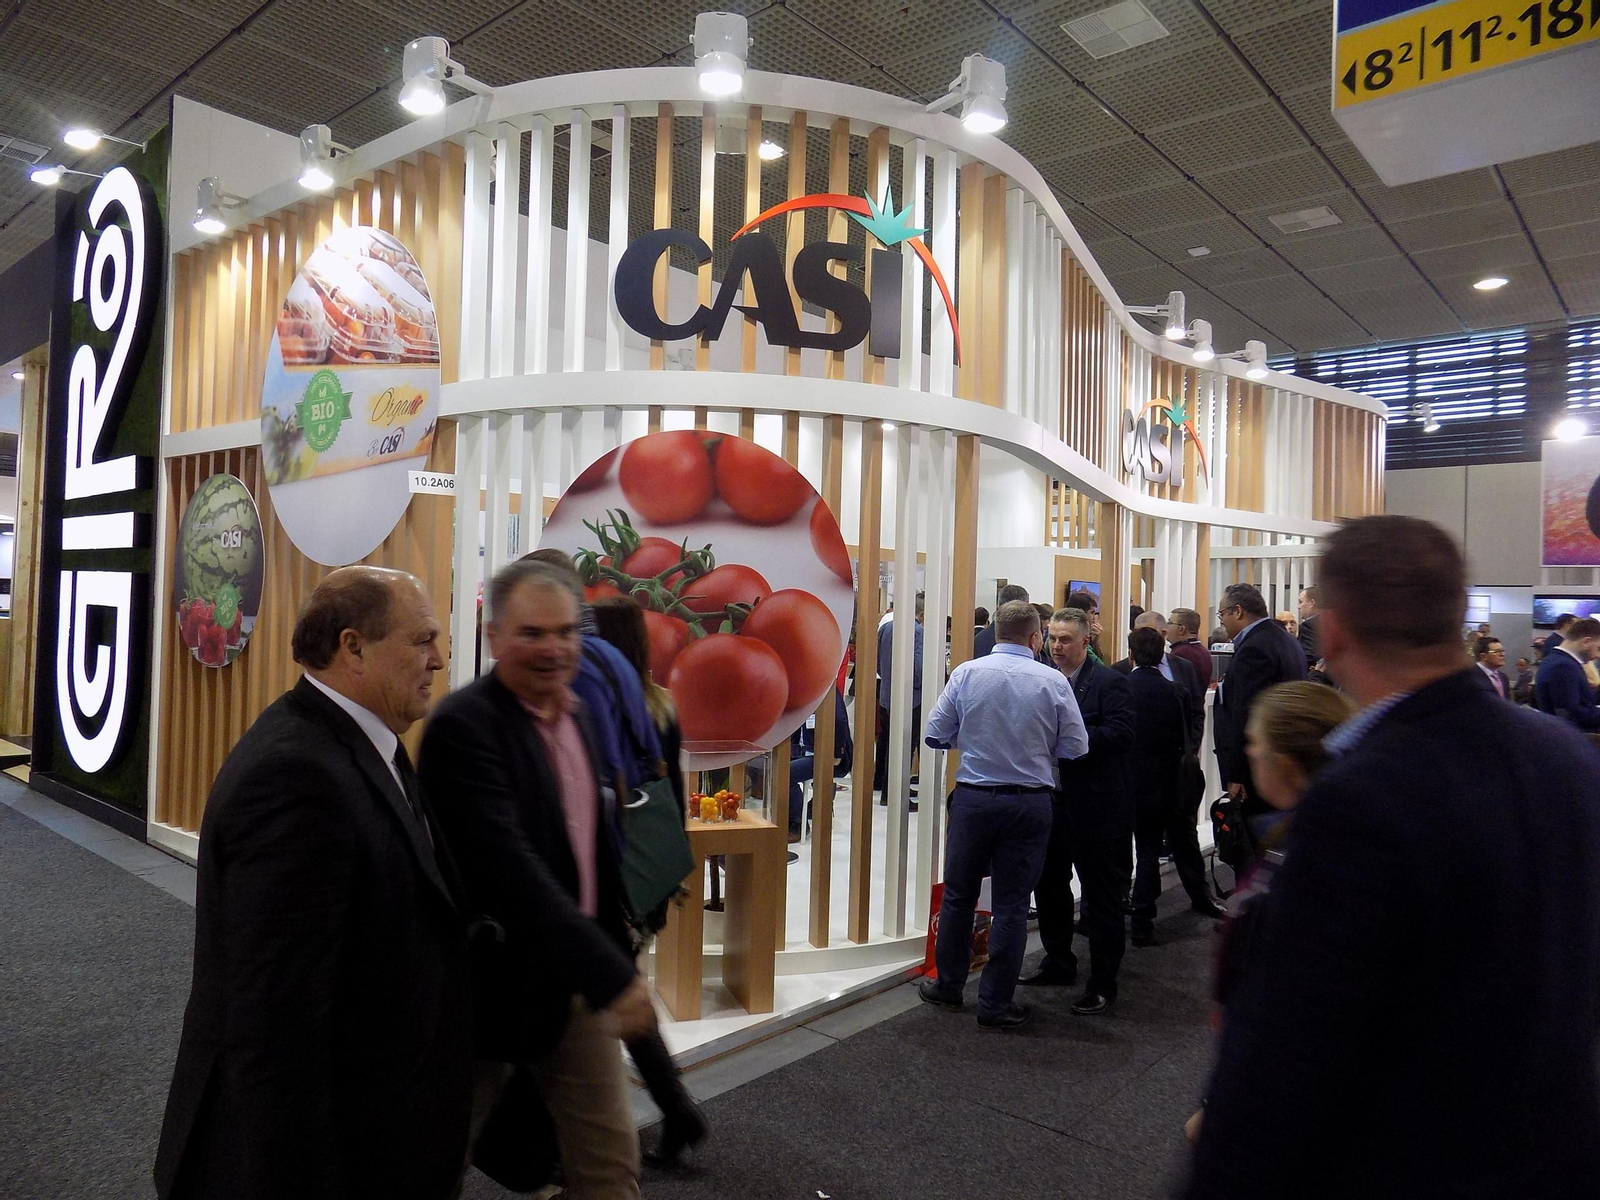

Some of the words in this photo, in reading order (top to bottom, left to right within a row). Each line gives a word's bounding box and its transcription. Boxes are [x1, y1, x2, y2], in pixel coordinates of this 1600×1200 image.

[614, 228, 904, 360] CASI
[311, 401, 334, 421] BIO
[371, 387, 423, 426] Organic
[379, 433, 402, 455] CASI
[1121, 408, 1183, 487] CASI
[414, 476, 455, 489] 10.2A06
[220, 530, 243, 549] CASI
